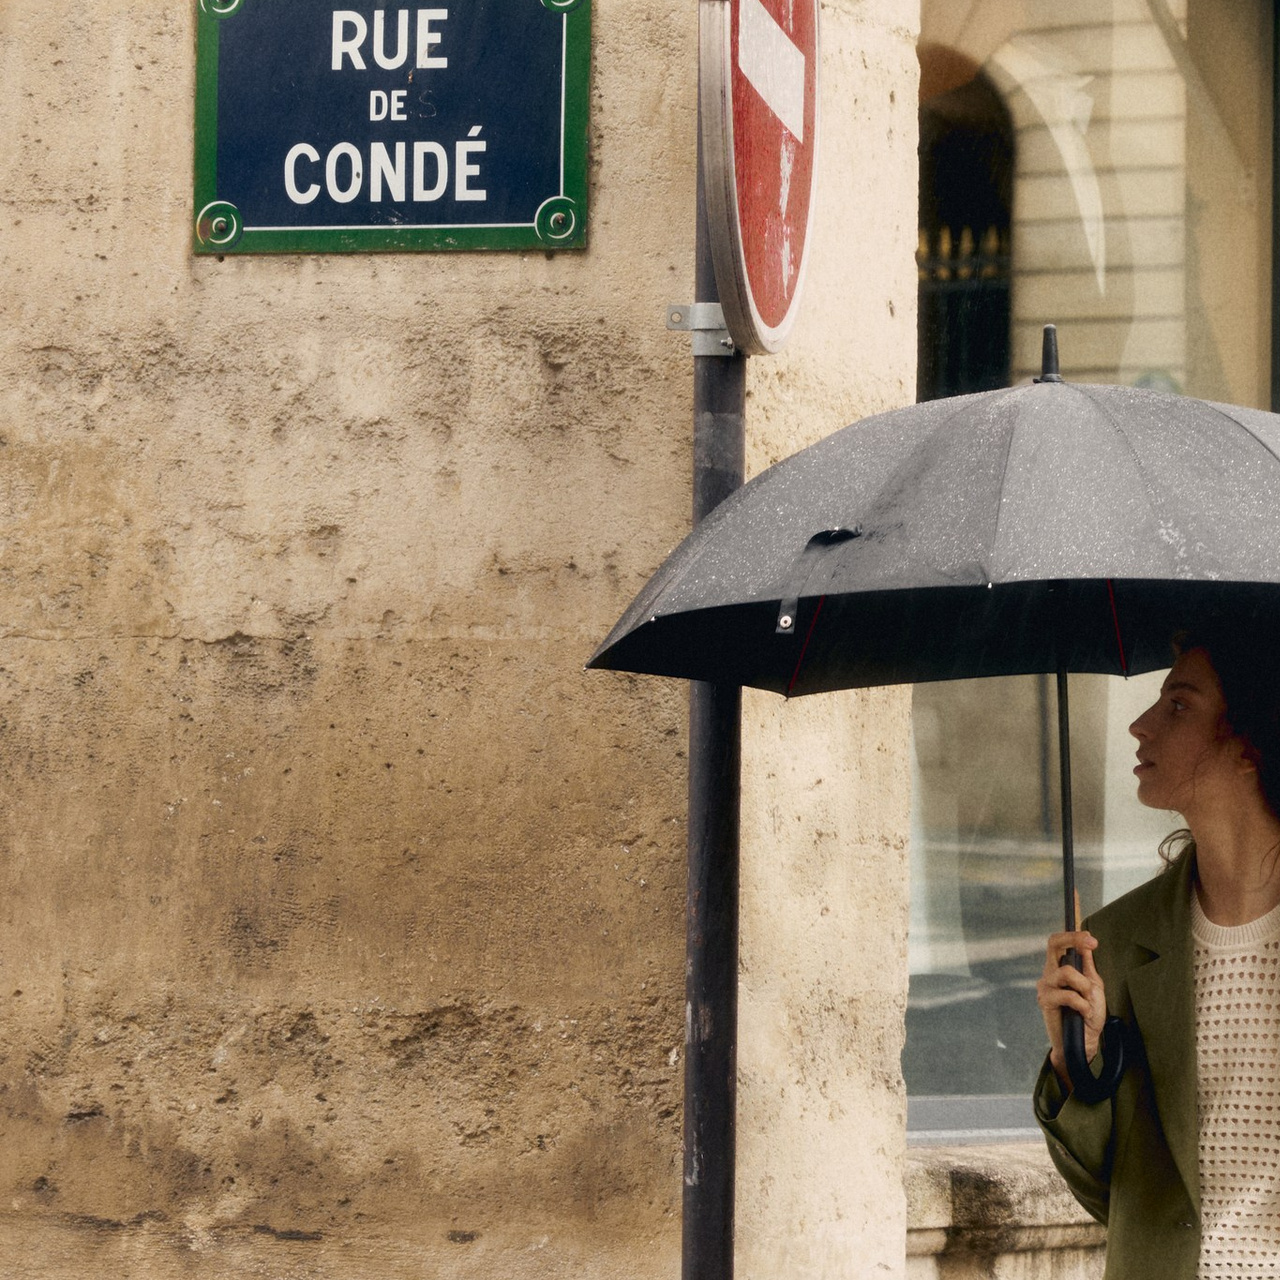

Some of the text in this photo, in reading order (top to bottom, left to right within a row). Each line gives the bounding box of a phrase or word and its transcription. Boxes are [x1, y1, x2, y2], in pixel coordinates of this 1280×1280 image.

[331, 8, 448, 70] RUE
[369, 90, 408, 121] DE
[284, 125, 487, 205] CONDÉ
